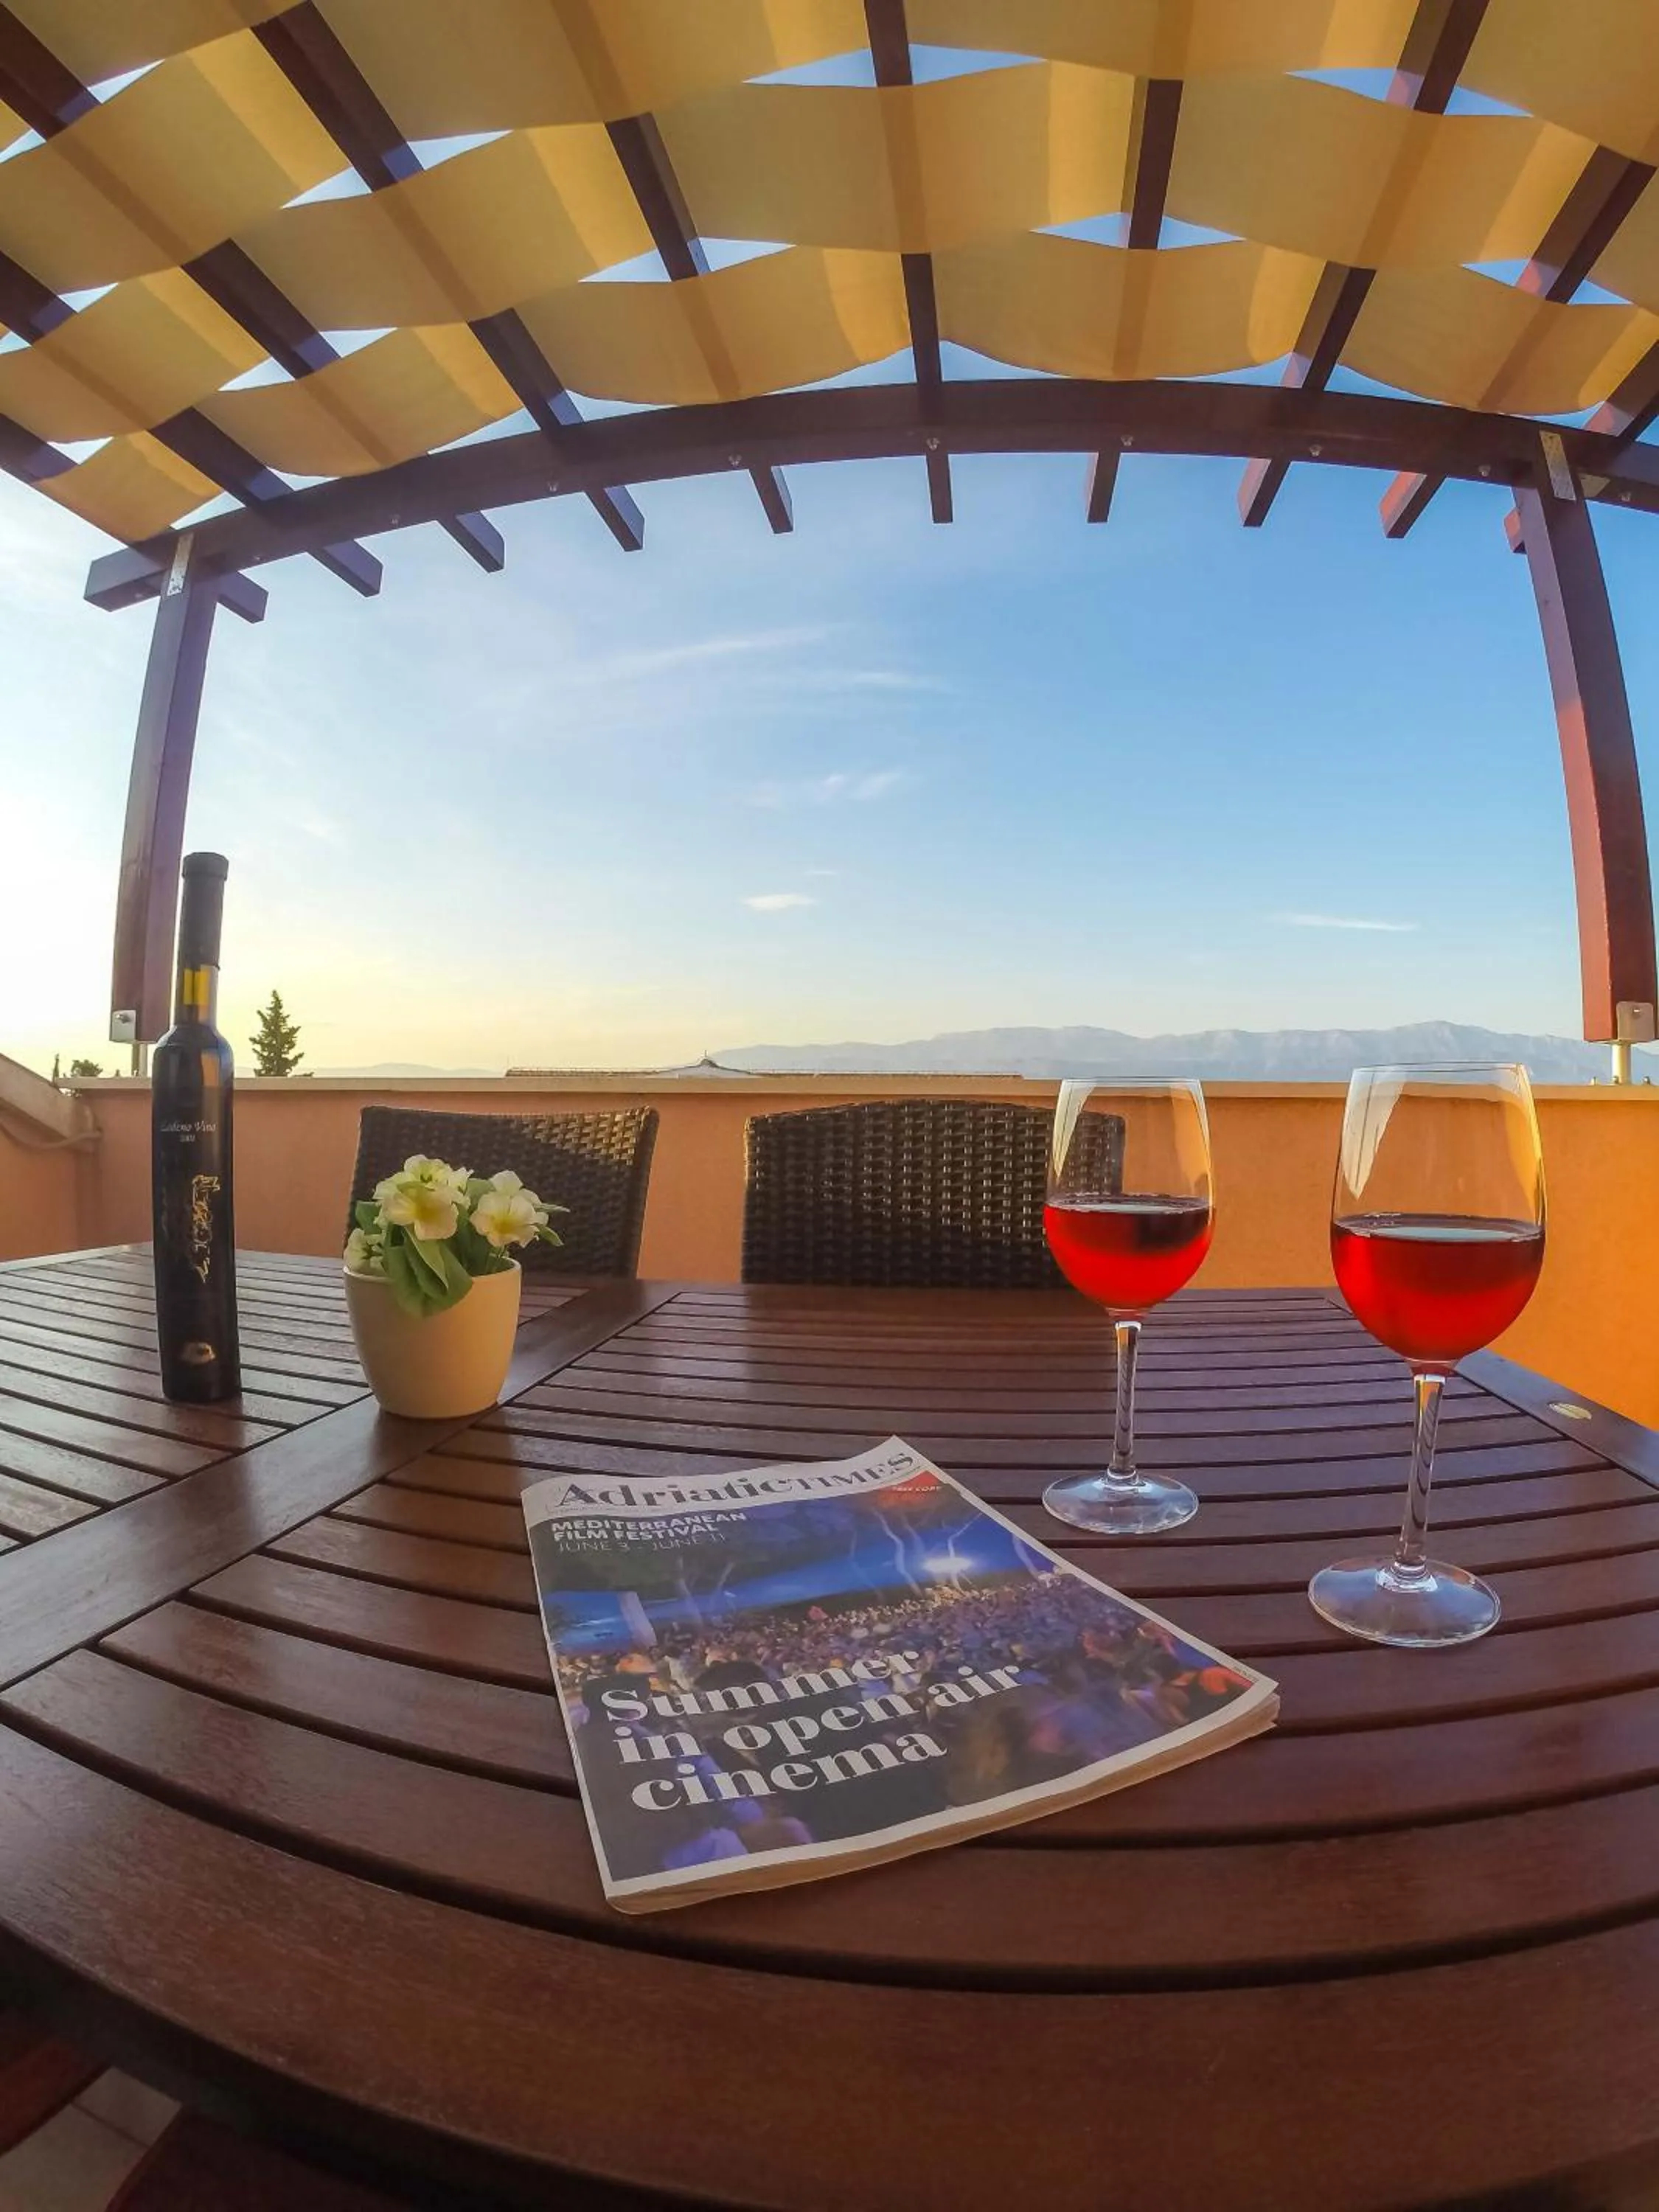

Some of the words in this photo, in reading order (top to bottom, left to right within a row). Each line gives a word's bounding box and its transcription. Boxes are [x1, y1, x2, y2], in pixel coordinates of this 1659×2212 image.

[552, 1512, 747, 1531] MEDITERRANEAN
[554, 1529, 610, 1542] FILM
[613, 1522, 720, 1541] FESTIVAL
[559, 1538, 612, 1553] JUNE
[652, 1535, 701, 1551] JUNE
[600, 1650, 919, 1722] Summer
[613, 1725, 703, 1764] in
[723, 1693, 919, 1756] open
[928, 1663, 1023, 1709] air
[630, 1731, 948, 1812] cinema
